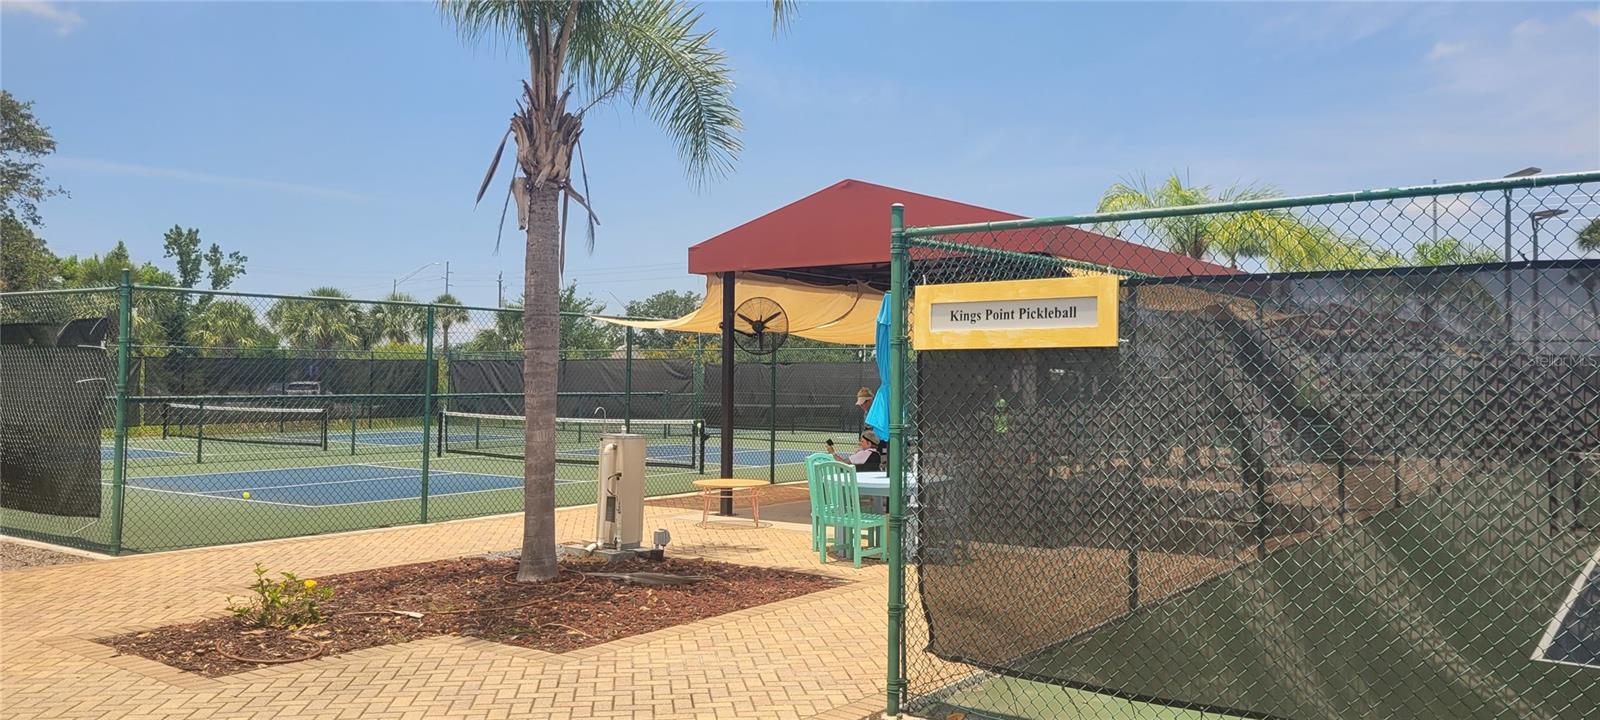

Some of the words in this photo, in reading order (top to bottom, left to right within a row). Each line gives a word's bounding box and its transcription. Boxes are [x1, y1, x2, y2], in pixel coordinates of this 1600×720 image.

[950, 309, 982, 325] Kings
[985, 308, 1015, 321] Point
[1019, 306, 1077, 320] Pickleball
